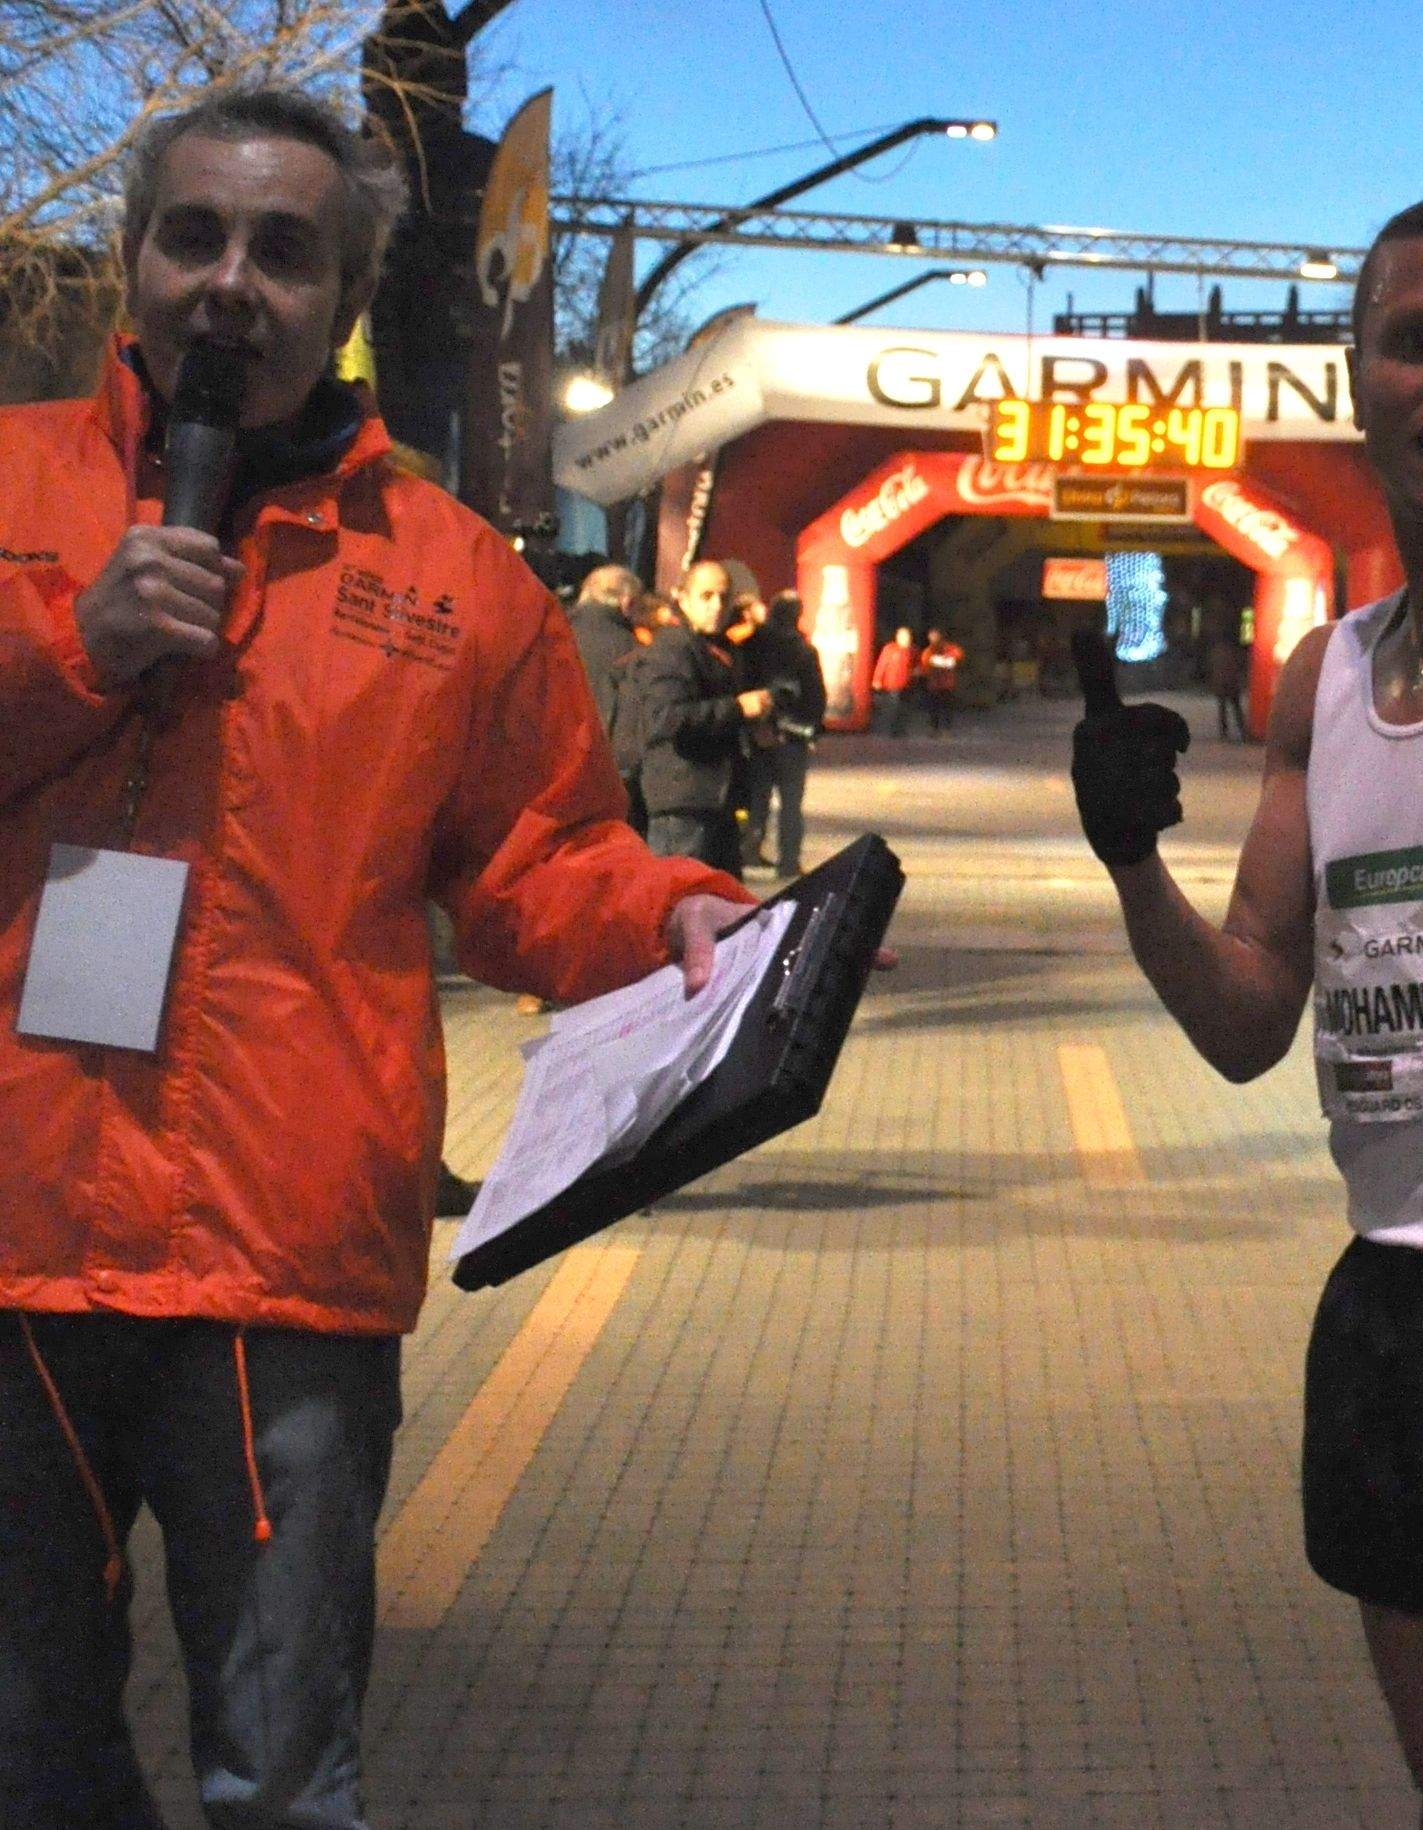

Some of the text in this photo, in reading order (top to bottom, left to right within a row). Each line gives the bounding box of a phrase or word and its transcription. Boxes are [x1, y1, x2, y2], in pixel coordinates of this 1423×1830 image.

[866, 347, 1338, 422] GARMIN
[574, 372, 734, 469] www.garmin.es
[340, 572, 417, 606] GARMN
[383, 602, 460, 638] Svestre
